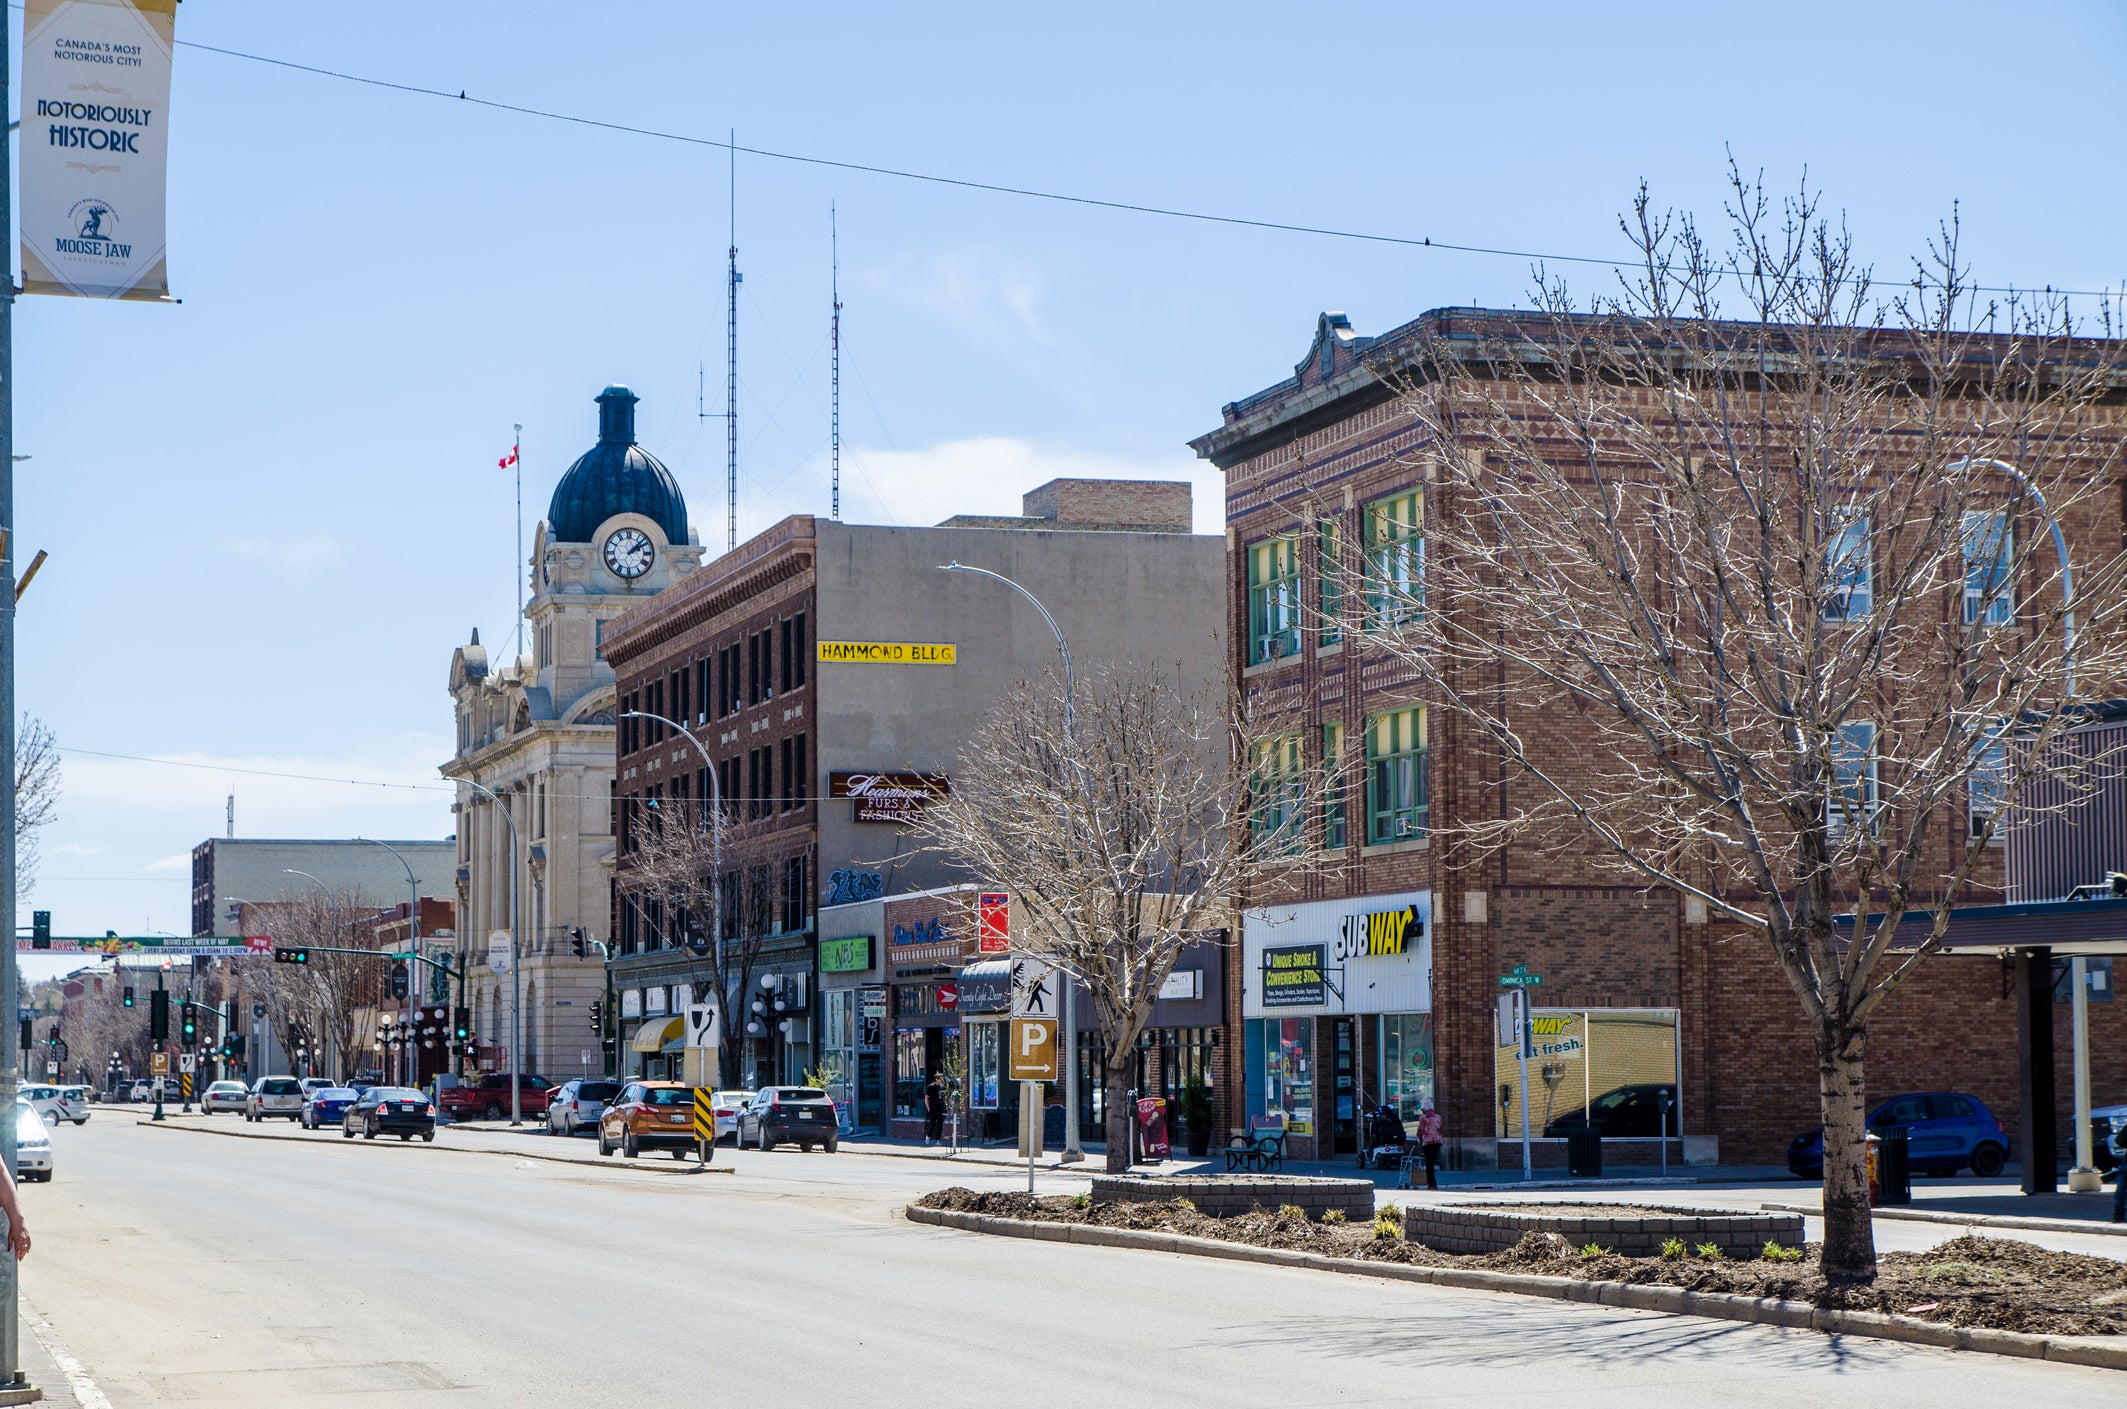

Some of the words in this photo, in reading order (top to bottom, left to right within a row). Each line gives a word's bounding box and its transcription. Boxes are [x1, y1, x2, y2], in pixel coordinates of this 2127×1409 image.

[56, 38, 110, 52] CANADA'S
[113, 45, 141, 55] MOST
[54, 51, 114, 65] NOTORIOUS
[117, 57, 142, 67] CITY!
[37, 99, 152, 126] NOTORIOUSLY
[49, 124, 139, 153] HISTORIC
[55, 238, 102, 256] MOOSE
[105, 243, 132, 259] JAW
[822, 645, 903, 659] HAMMOND
[868, 798, 899, 808] FURS
[903, 799, 910, 808] &
[1333, 906, 1414, 960] SUBWAY
[1272, 954, 1292, 968] UNIQUE
[1293, 952, 1311, 967] SMOKE
[1312, 950, 1317, 966] &
[1266, 970, 1302, 986] CONVENIENCE
[1525, 976, 1532, 984] ST
[1022, 1023, 1048, 1056] P
[155, 1054, 166, 1067] P
